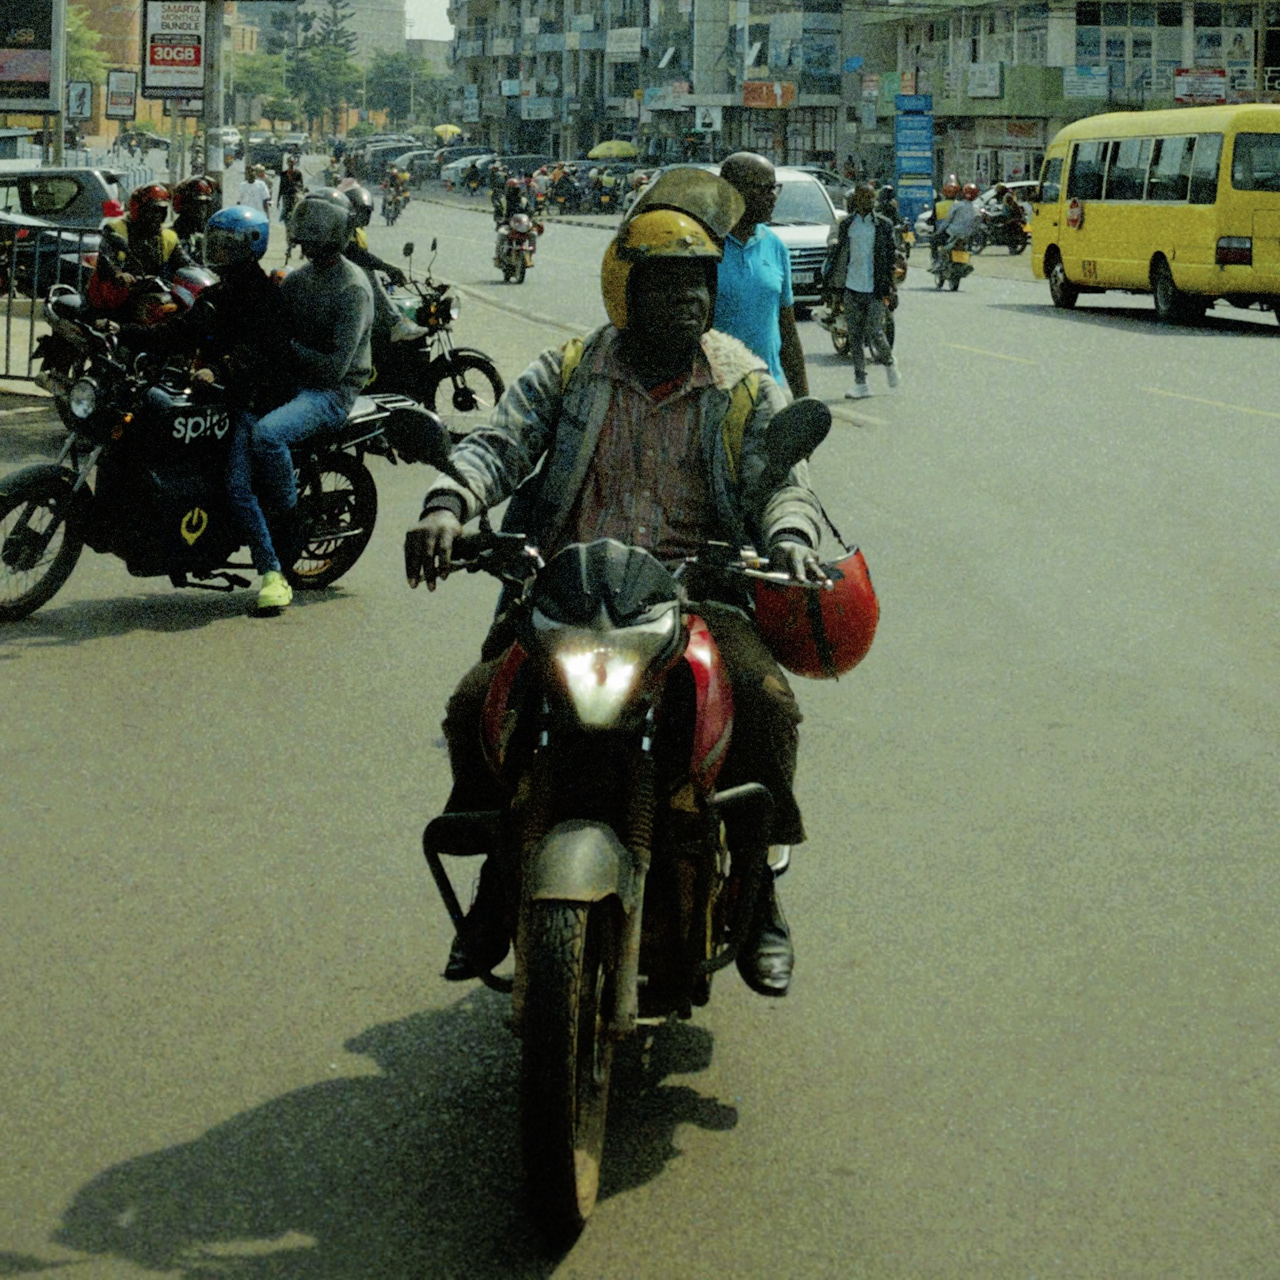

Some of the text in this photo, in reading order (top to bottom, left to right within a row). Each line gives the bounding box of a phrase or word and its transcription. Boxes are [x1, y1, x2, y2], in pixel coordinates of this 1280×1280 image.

[161, 4, 200, 13] SMARTA
[161, 22, 200, 30] BUNDLE
[154, 47, 195, 61] 30GB
[172, 409, 230, 444] spiro
